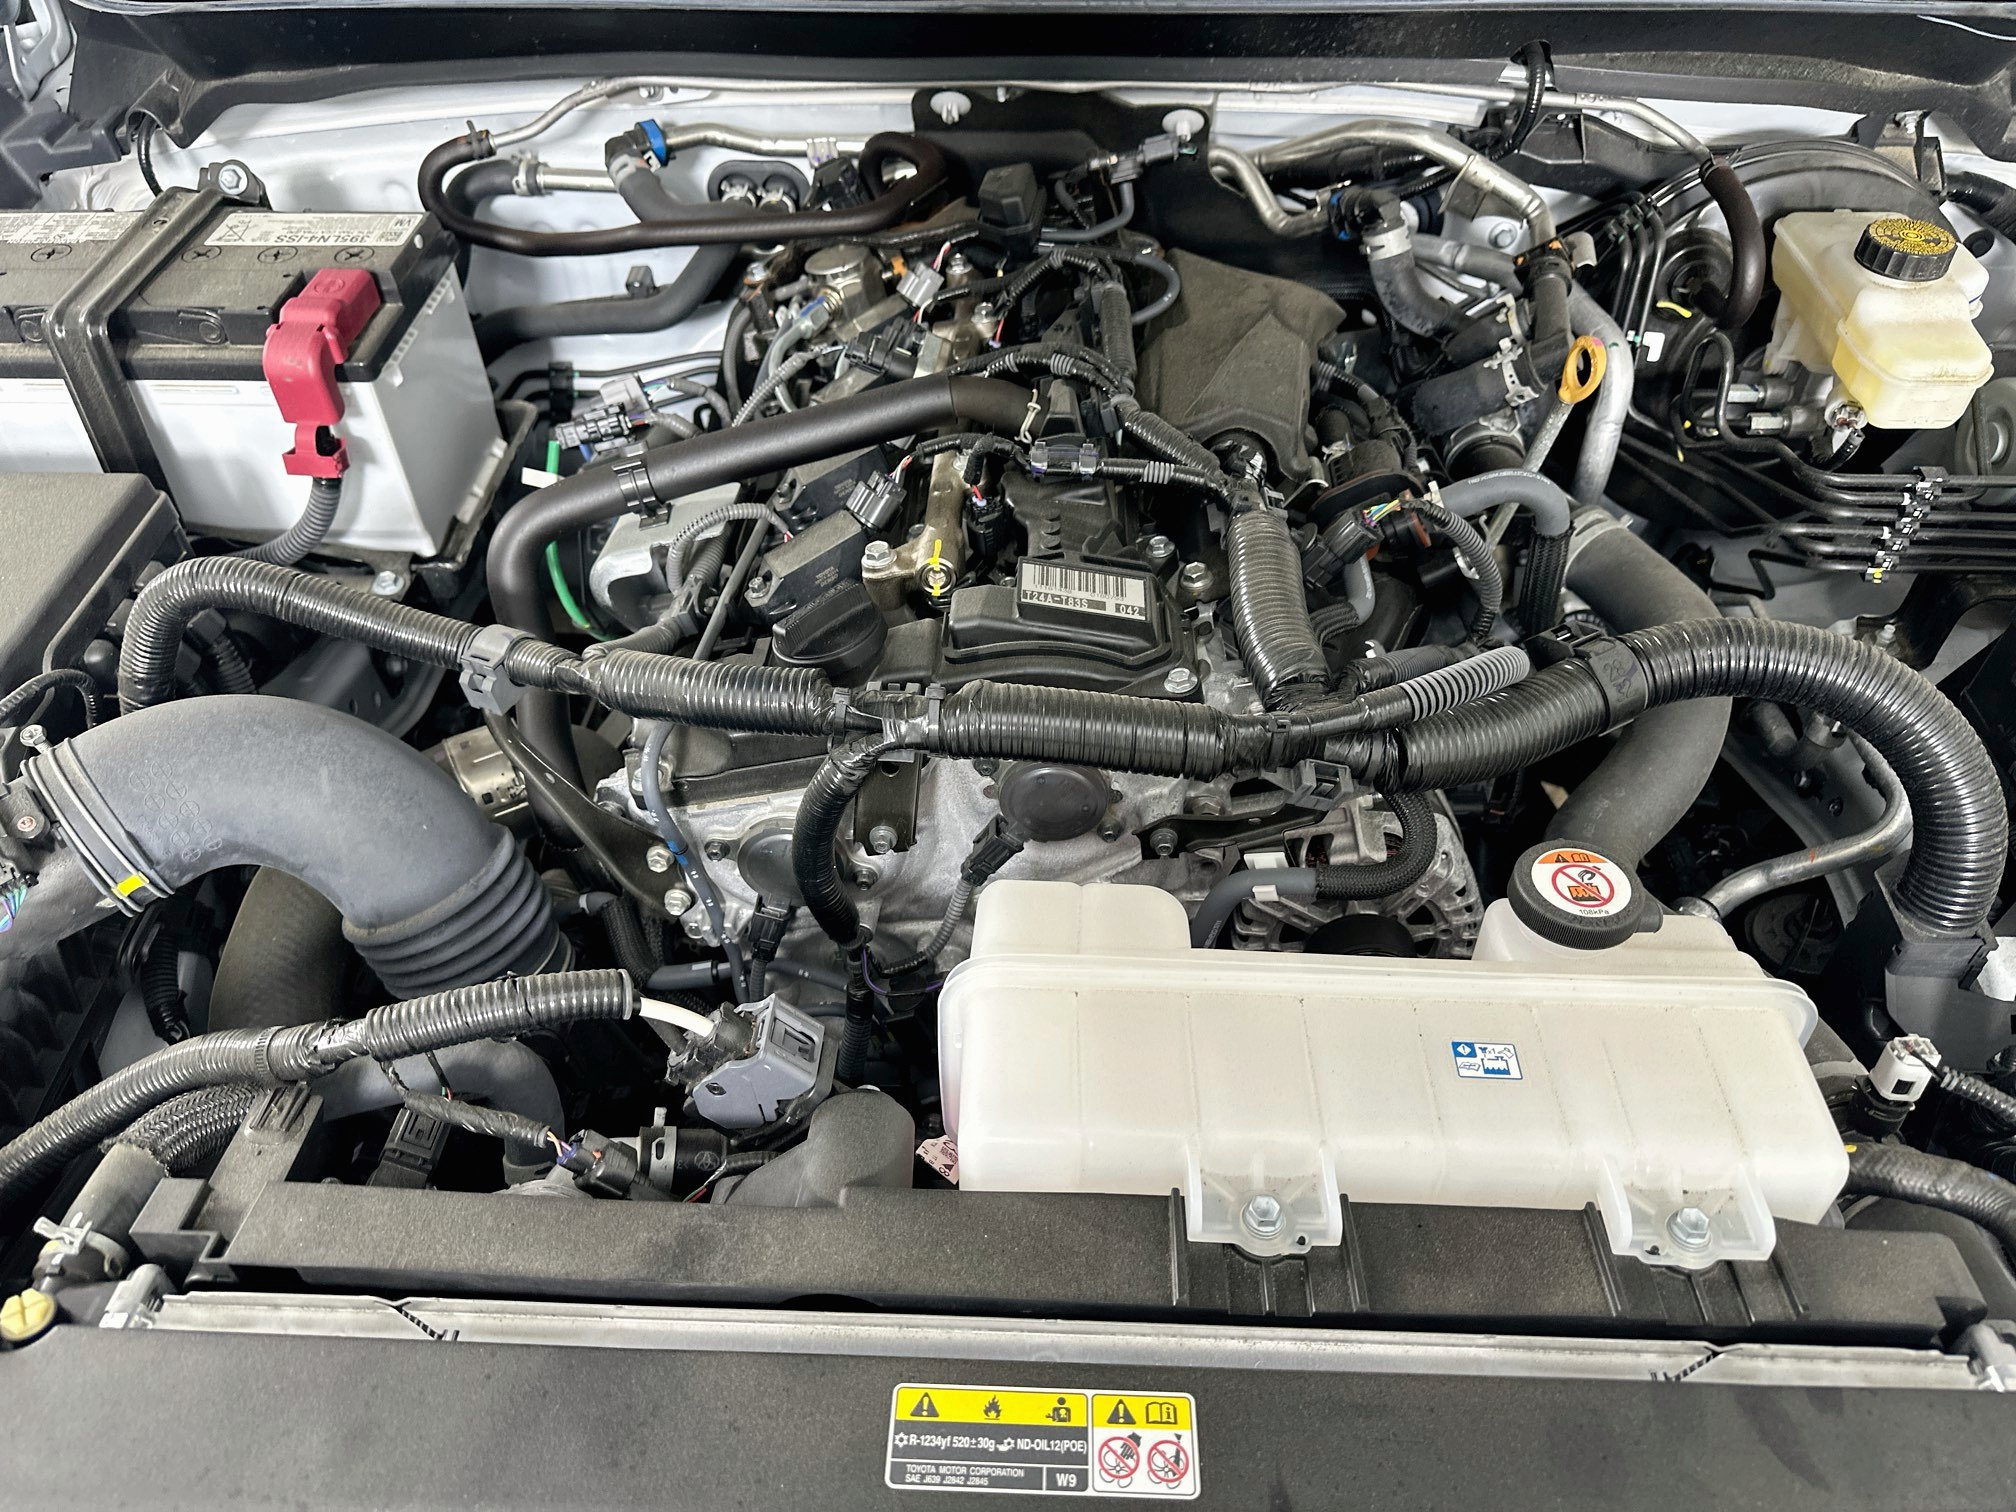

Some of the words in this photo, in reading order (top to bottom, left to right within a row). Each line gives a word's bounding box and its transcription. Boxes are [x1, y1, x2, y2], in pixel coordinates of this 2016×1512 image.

[274, 235, 370, 243] 395LN4-ISS
[1025, 590, 1089, 609] T24A-T83S
[1119, 605, 1140, 616] 042
[909, 1433, 952, 1449] R-1234yf
[953, 1435, 996, 1451] 520±30g
[1016, 1438, 1088, 1454] ND-OIL12(POE)
[905, 1463, 937, 1474] TOYOTA
[938, 1465, 967, 1475] MOTOR
[969, 1466, 1025, 1478] CORPORATION
[904, 1473, 922, 1483] SAE
[922, 1474, 941, 1484] J639
[942, 1475, 965, 1485] J2842
[966, 1476, 989, 1486] J2845
[1055, 1473, 1078, 1488] W9
